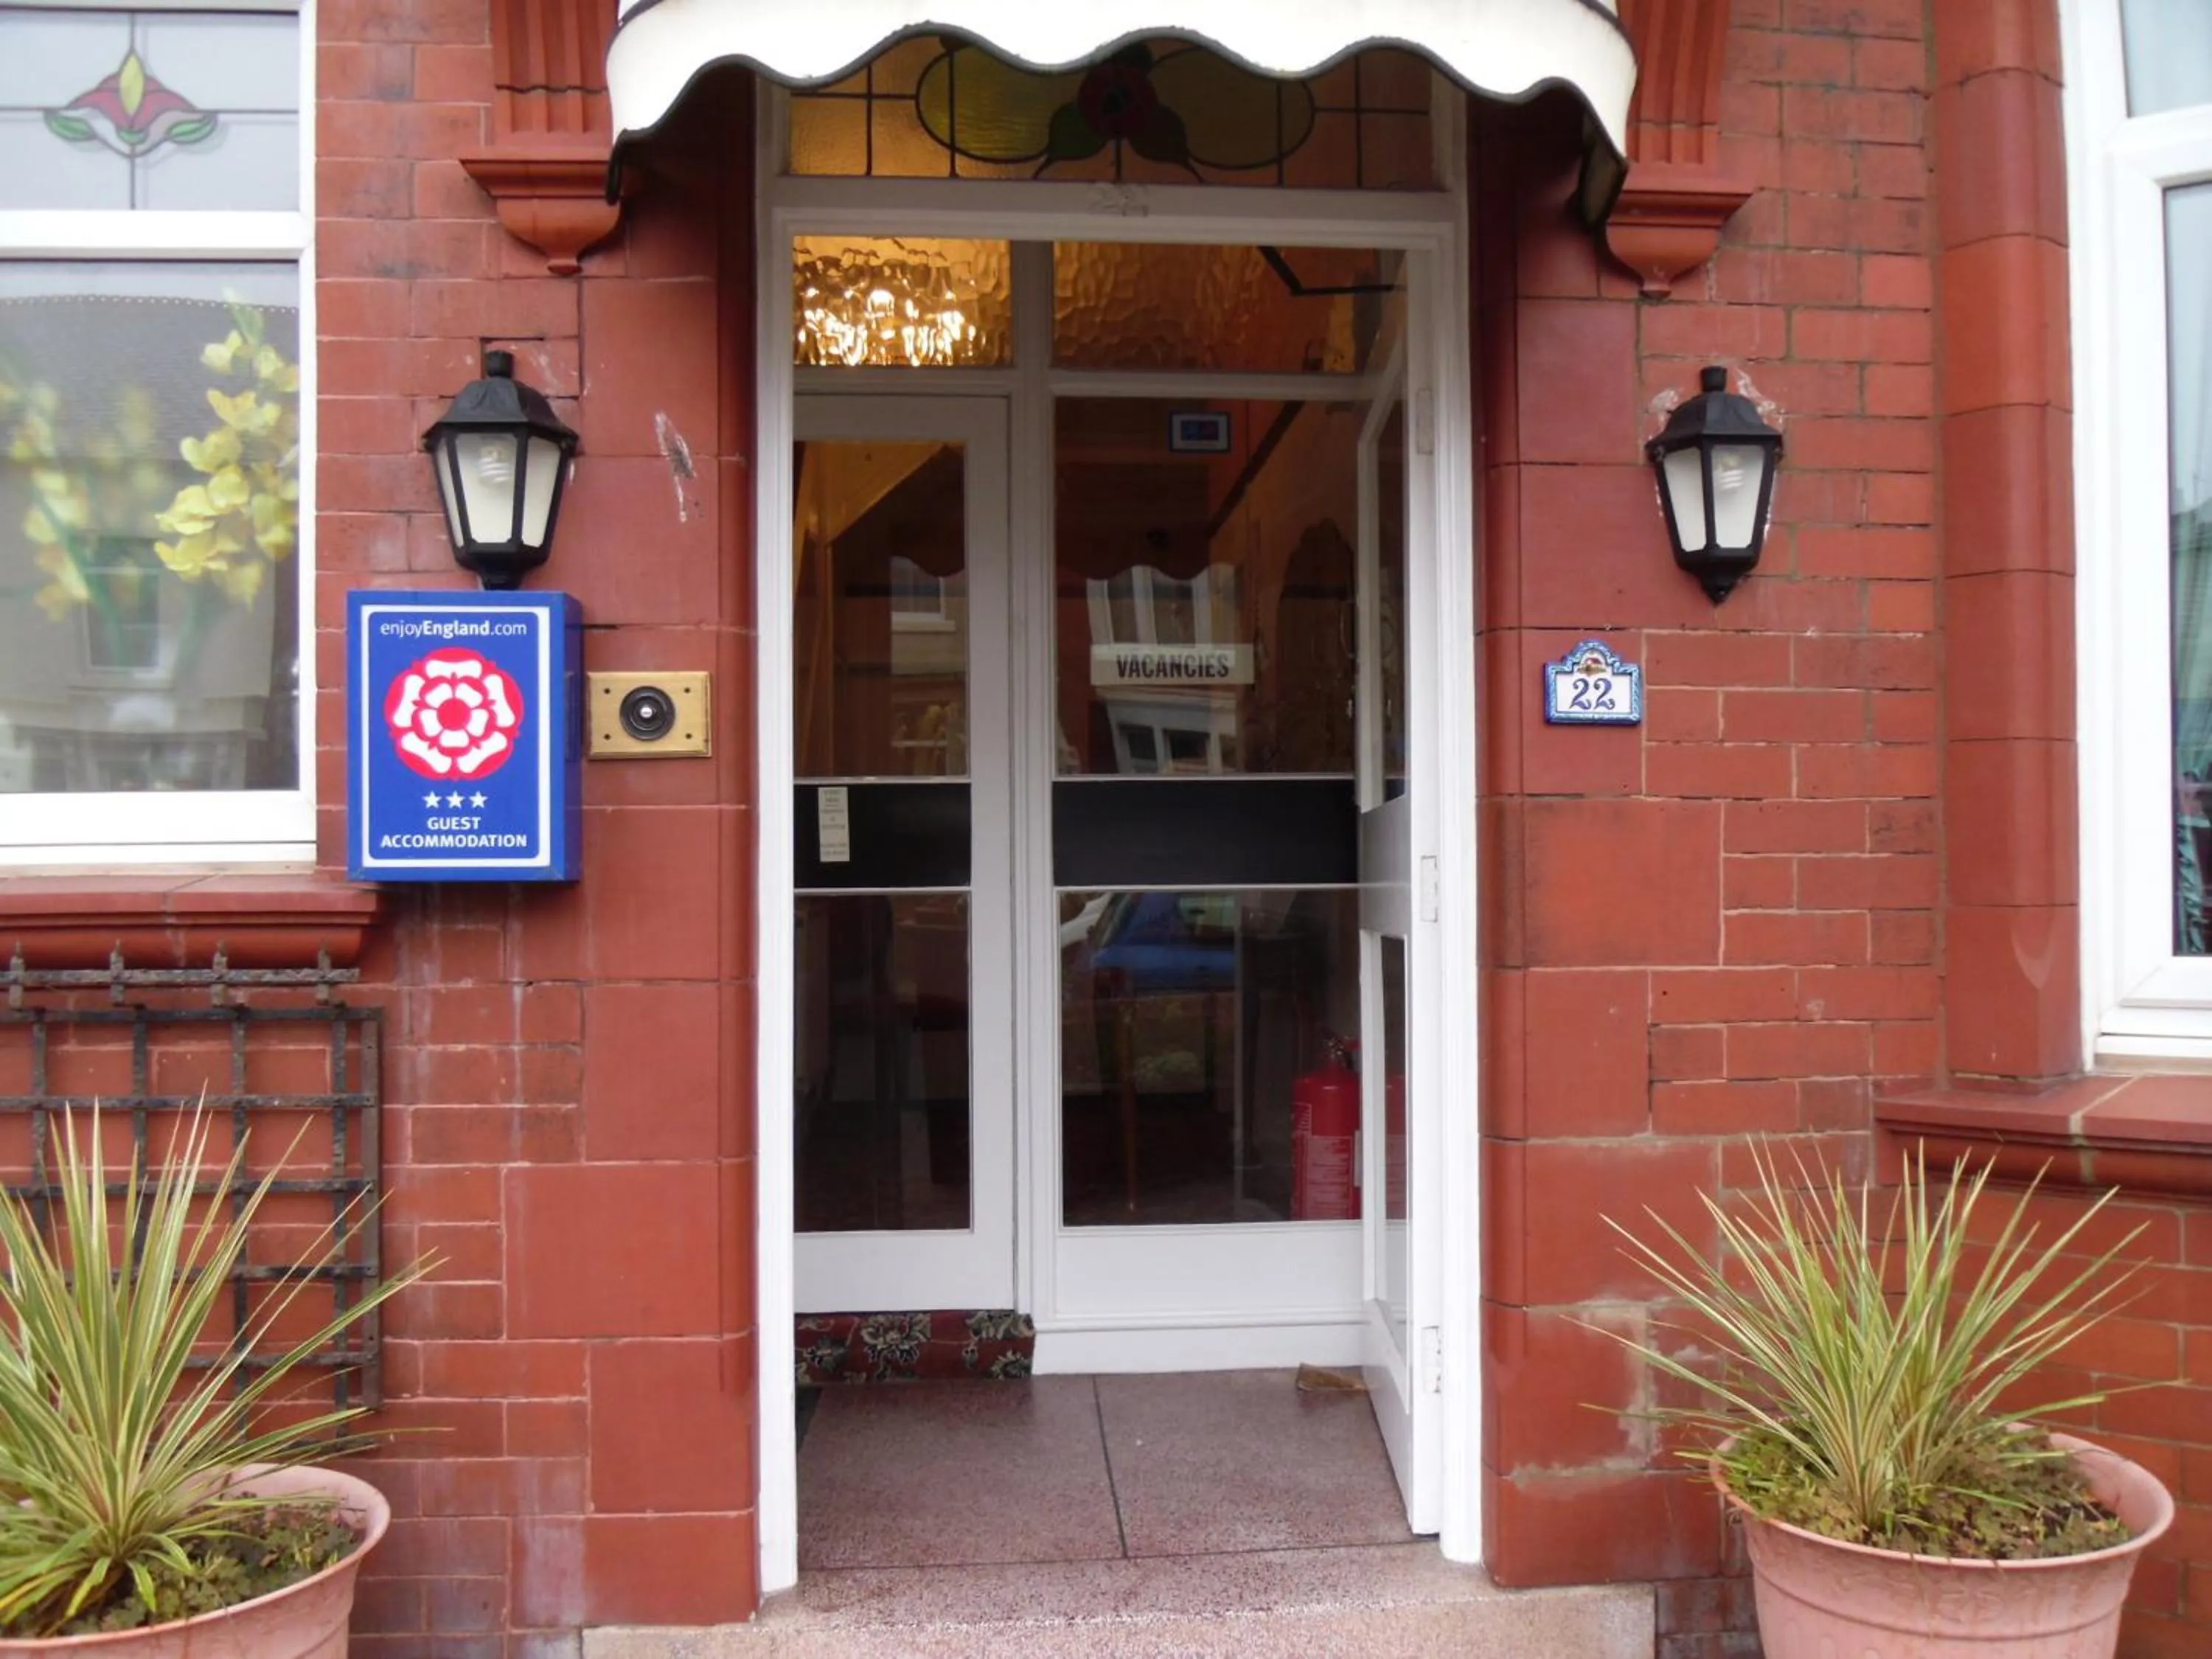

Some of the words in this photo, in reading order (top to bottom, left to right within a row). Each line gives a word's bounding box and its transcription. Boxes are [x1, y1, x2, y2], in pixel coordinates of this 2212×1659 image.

[380, 620, 526, 639] enjoyEngland.com
[1116, 654, 1229, 678] VACANCIES
[1570, 678, 1615, 710] 22
[427, 816, 481, 830] GUEST
[380, 835, 527, 848] ACCOMMODATION
